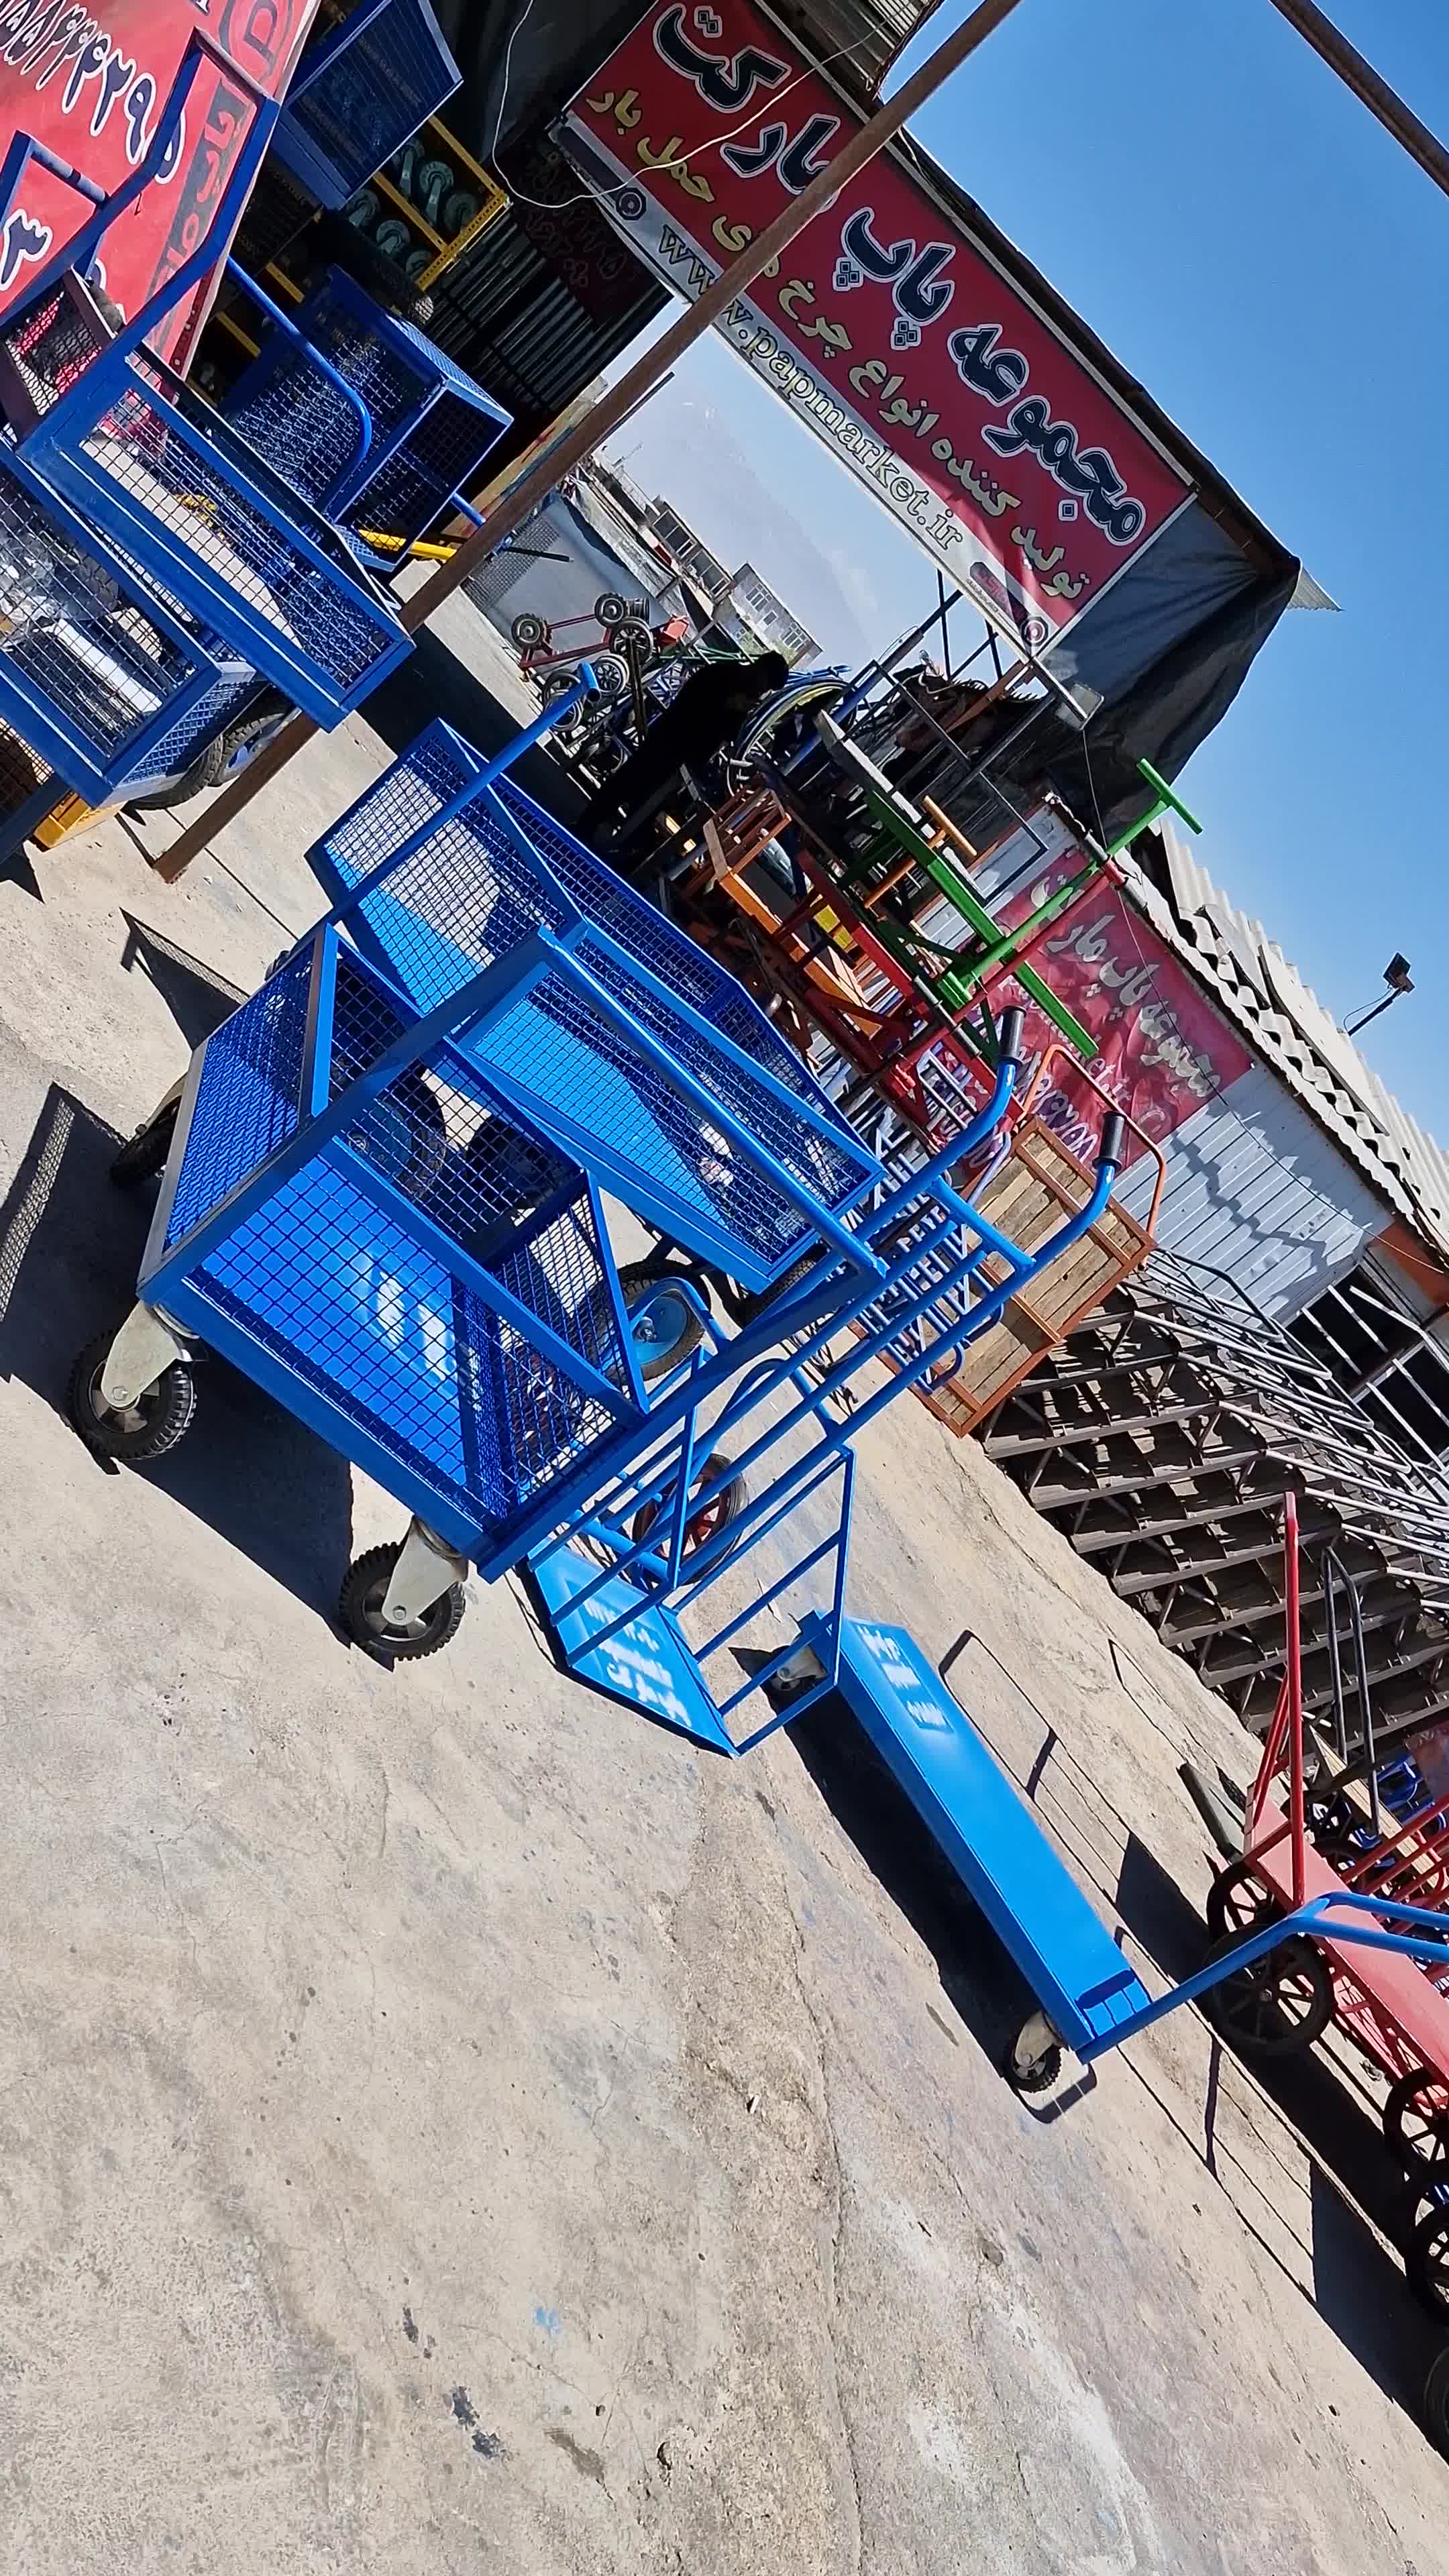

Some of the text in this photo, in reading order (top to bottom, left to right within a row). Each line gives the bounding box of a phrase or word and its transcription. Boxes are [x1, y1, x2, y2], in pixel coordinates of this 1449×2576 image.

[586, 89, 643, 136] بار
[636, 136, 715, 203] حمل
[711, 215, 781, 278] هی
[832, 206, 956, 351] پاپ
[778, 278, 854, 359] چرخ
[848, 359, 941, 437] انواع
[947, 323, 1146, 547] مجموعه
[930, 438, 1022, 517] کننده
[1010, 525, 1090, 599] تولید
[1084, 957, 1160, 1021] پاپ
[1140, 1000, 1220, 1098] مجموعه
